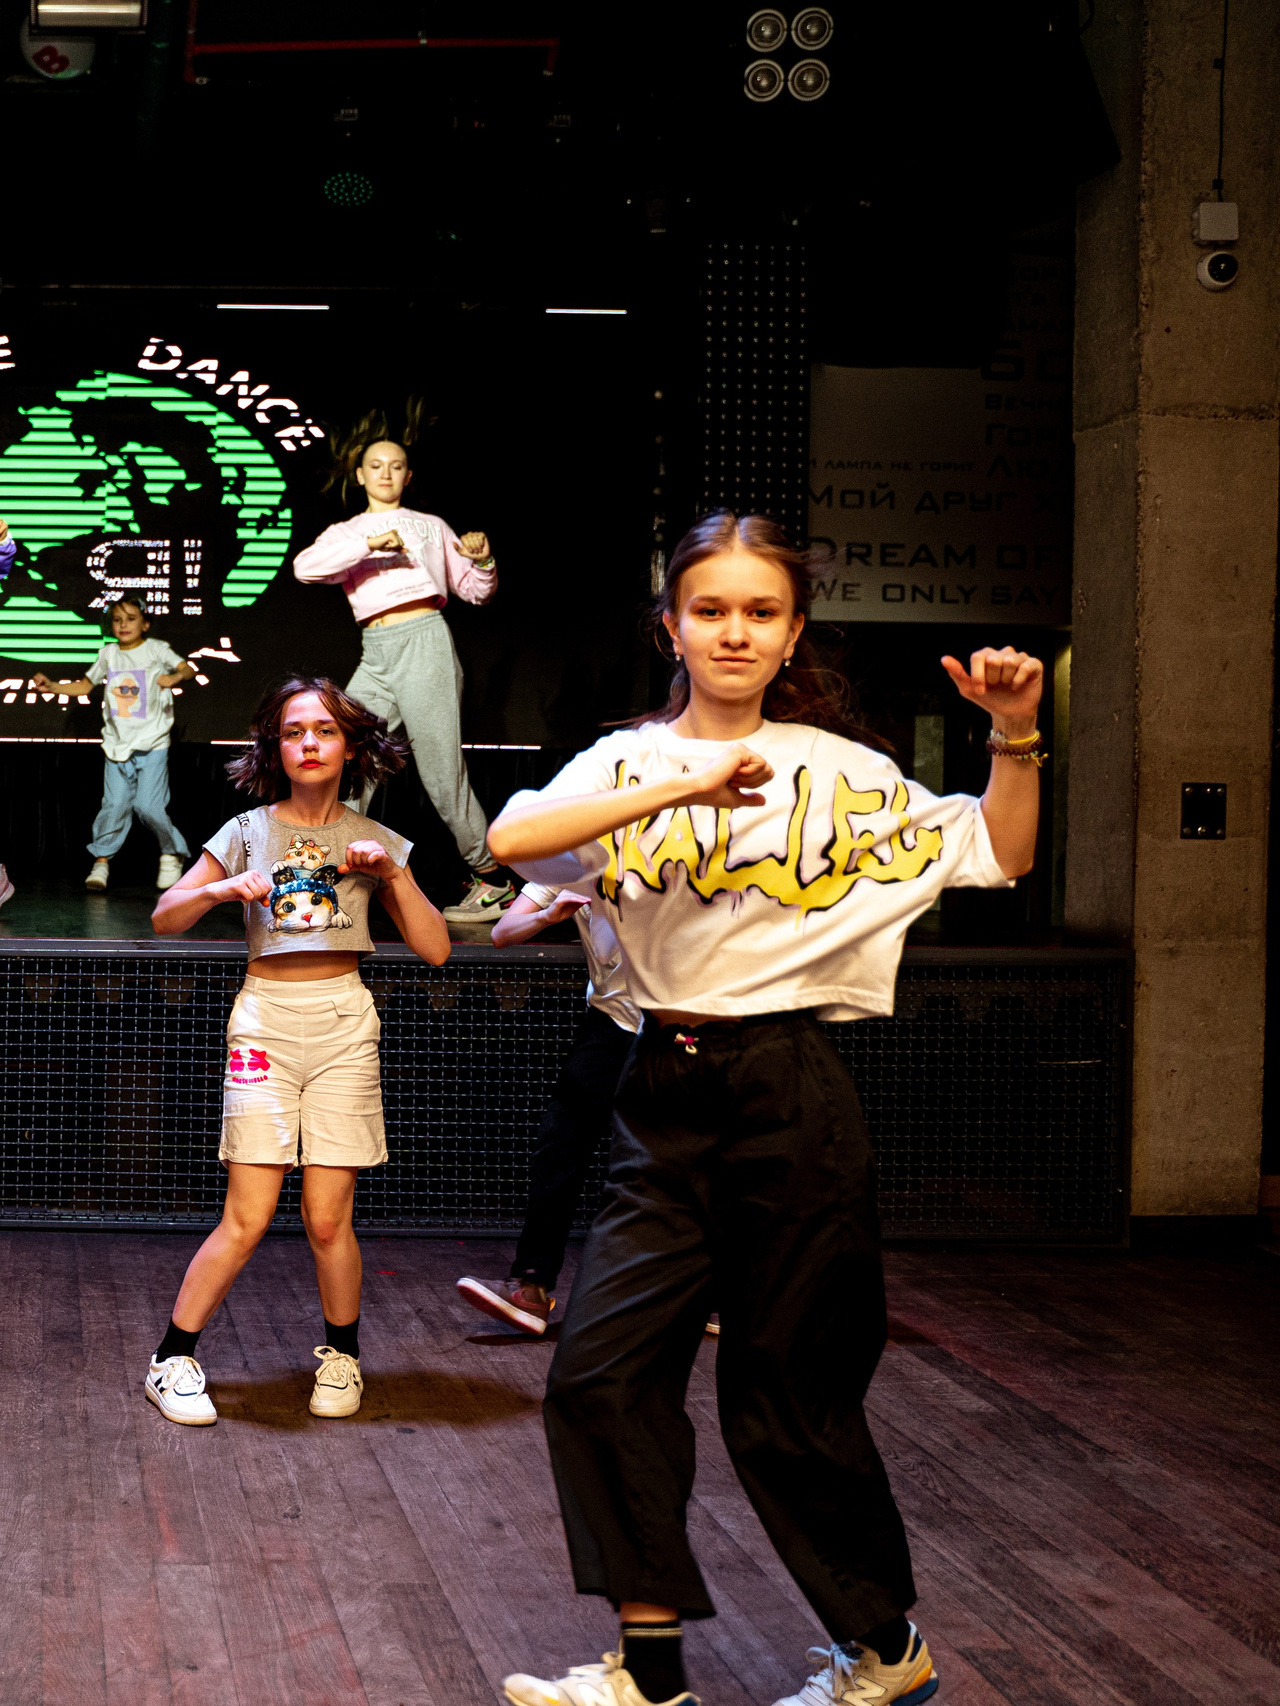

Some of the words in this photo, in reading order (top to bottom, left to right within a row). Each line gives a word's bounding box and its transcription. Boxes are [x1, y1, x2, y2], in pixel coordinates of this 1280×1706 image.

[138, 337, 324, 451] DANCE
[882, 583, 977, 604] ONLY
[990, 586, 1059, 605] SAY
